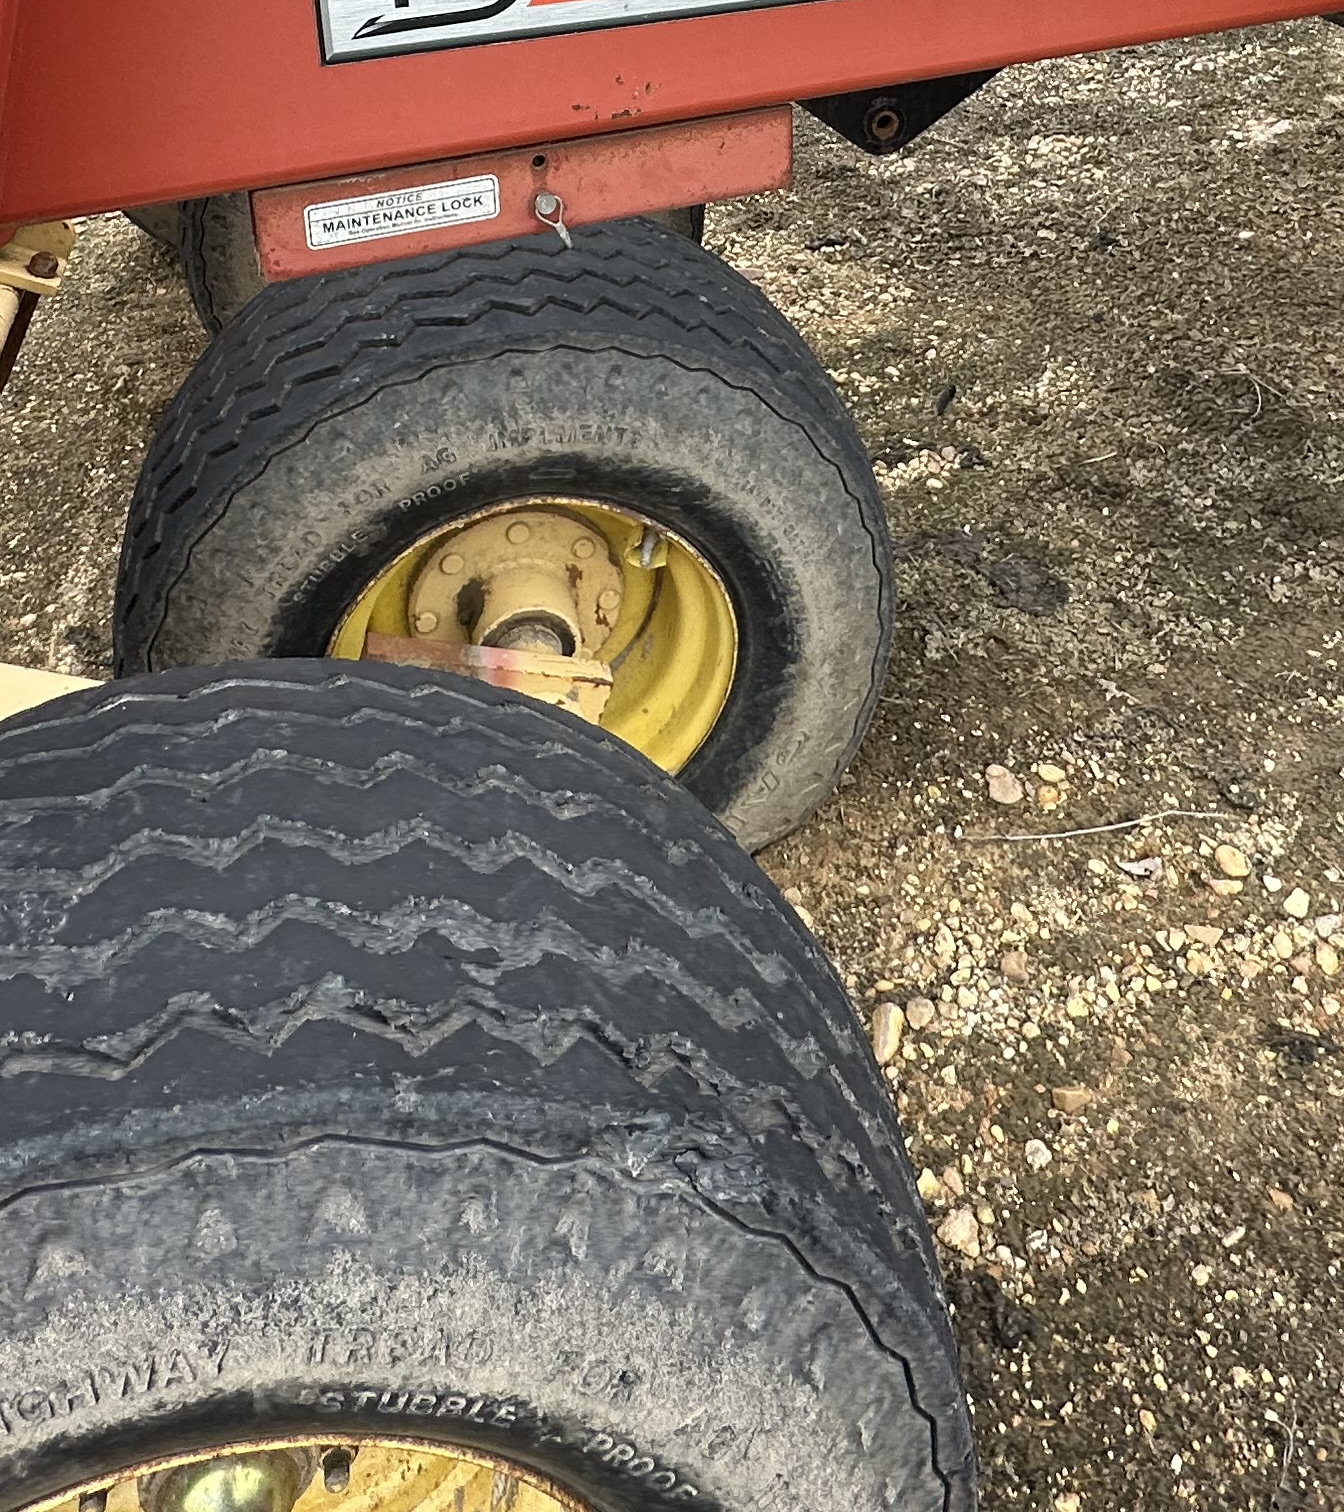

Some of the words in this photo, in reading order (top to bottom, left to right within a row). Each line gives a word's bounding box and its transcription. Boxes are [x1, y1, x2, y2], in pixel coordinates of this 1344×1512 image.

[322, 205, 437, 234] MAINTENANCE
[442, 195, 484, 213] LOCK
[376, 192, 423, 209] NOTICE
[418, 447, 457, 474] AG
[398, 471, 471, 513] PROOF
[316, 1390, 519, 1428] STUBBLE
[582, 1431, 700, 1500] PROOF
